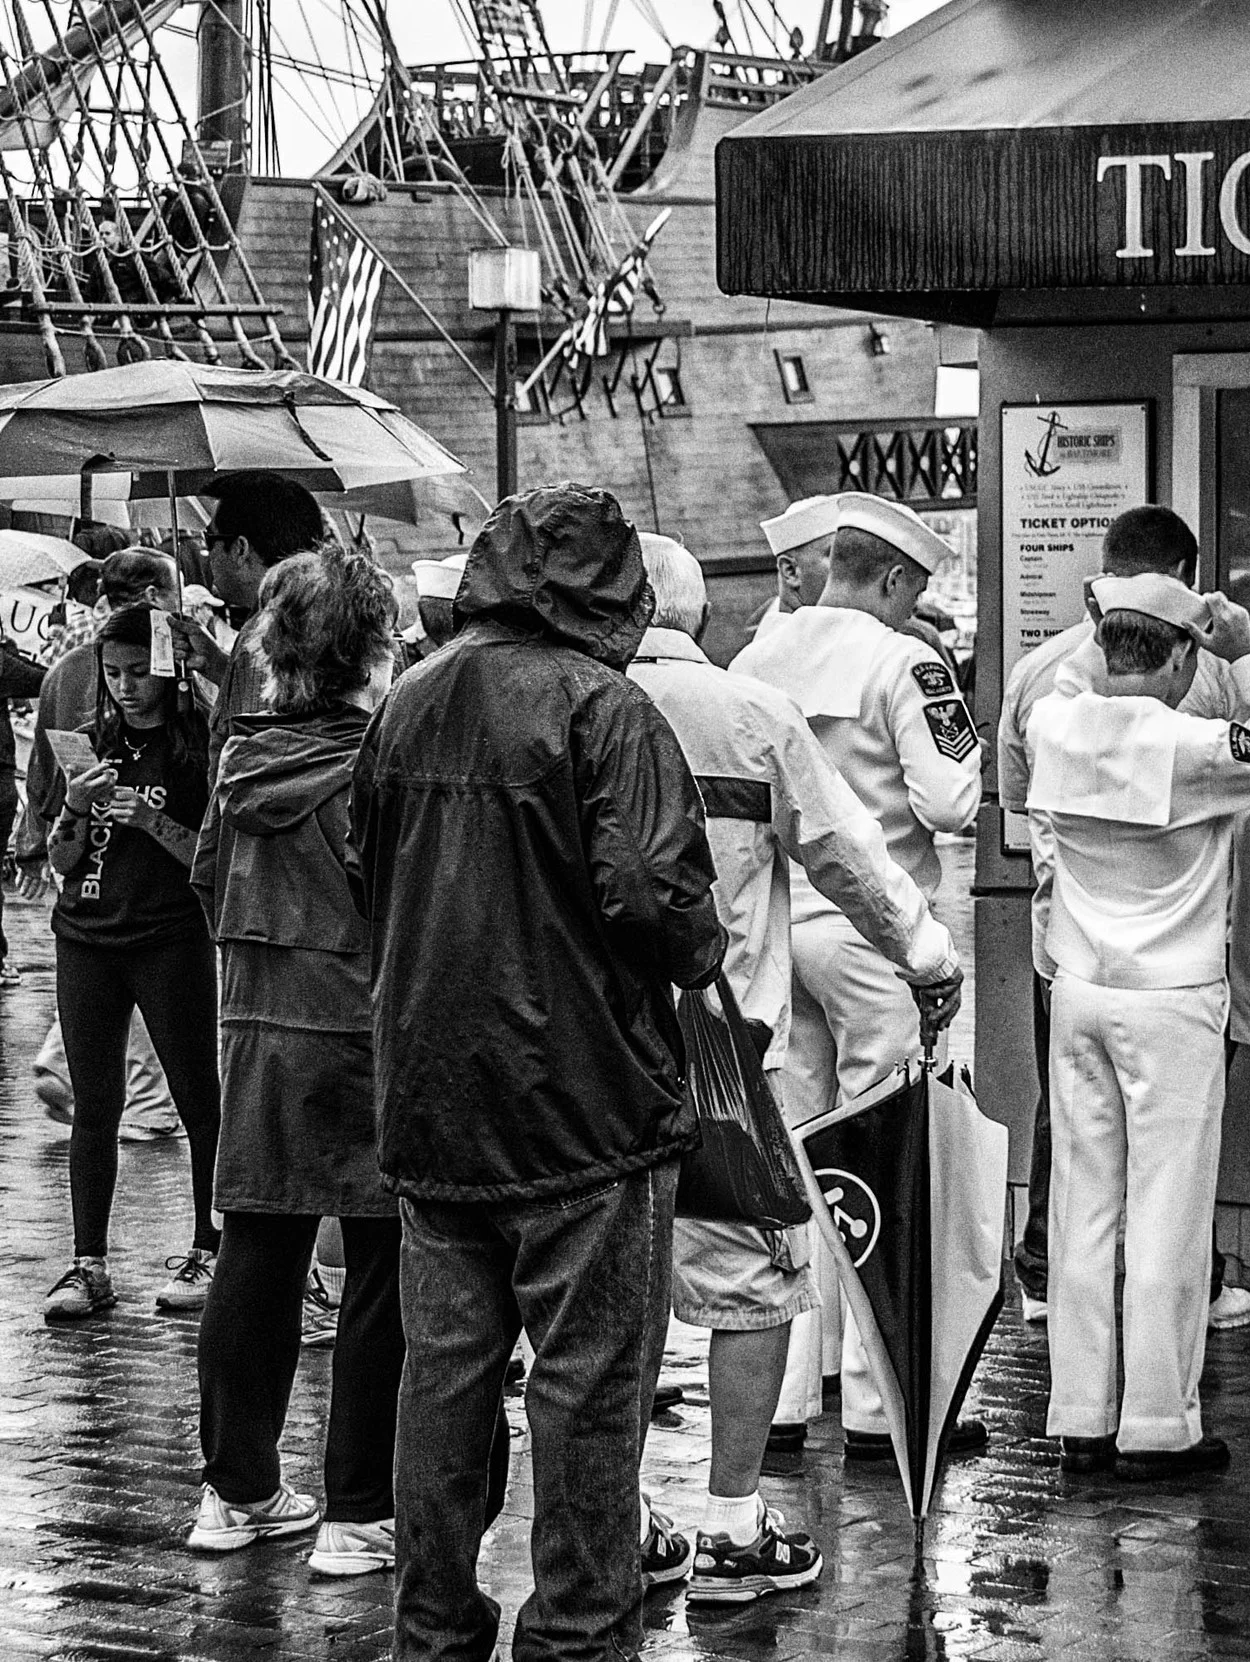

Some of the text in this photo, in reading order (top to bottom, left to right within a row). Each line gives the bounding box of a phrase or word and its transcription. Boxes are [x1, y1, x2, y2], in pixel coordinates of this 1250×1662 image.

[1057, 434, 1115, 448] HISTORIC SHIPS
[1020, 517, 1115, 529] TICKET OPTIO
[1020, 543, 1075, 552] FOUR SHIPS
[1020, 628, 1041, 638] TWO
